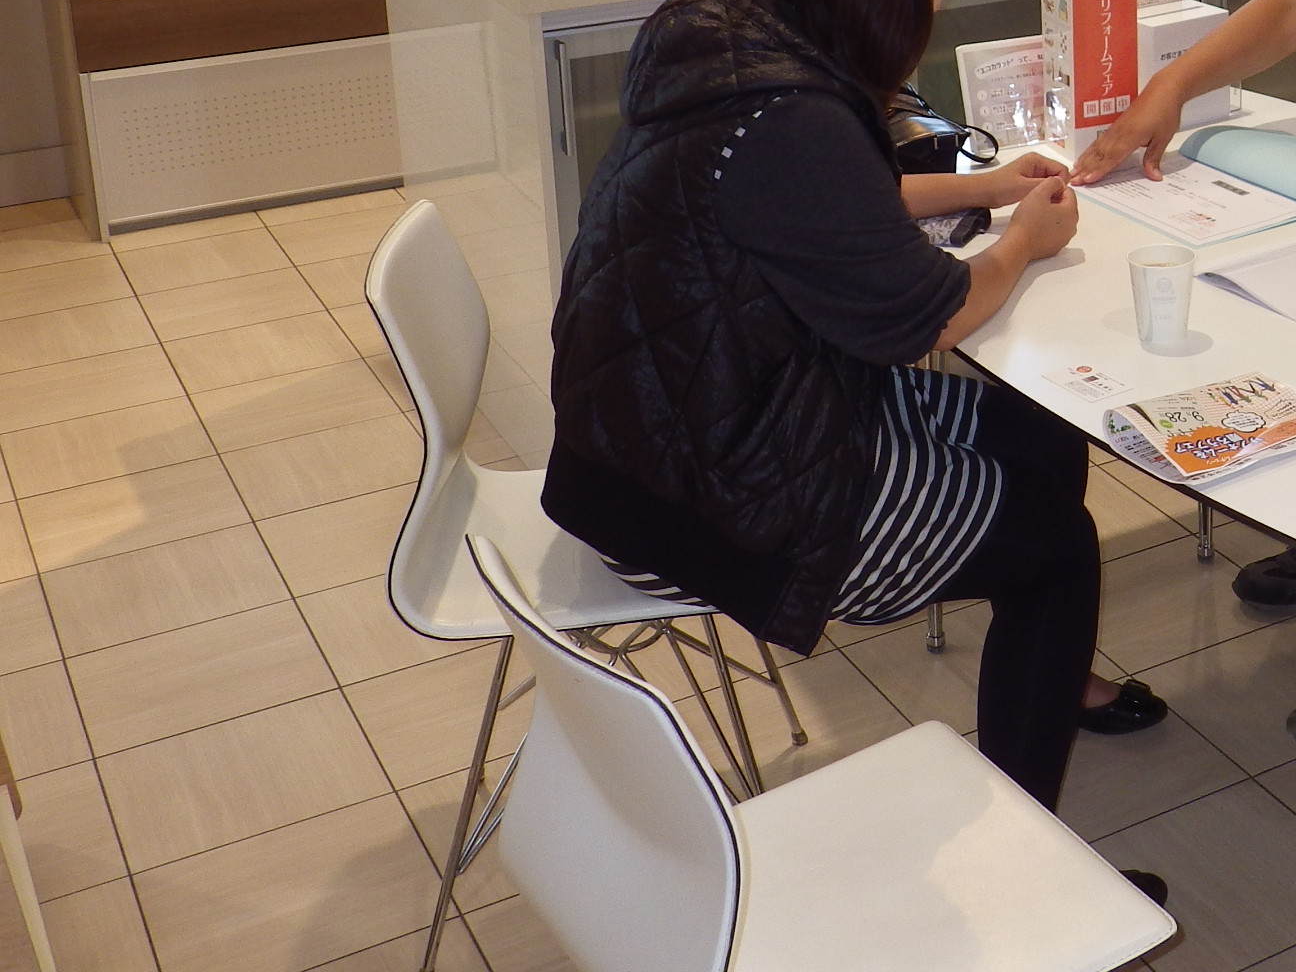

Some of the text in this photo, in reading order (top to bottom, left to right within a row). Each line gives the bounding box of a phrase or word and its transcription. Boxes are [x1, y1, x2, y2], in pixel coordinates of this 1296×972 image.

[1160, 48, 1189, 61] お客さま
[1085, 96, 1131, 116] 開催中
